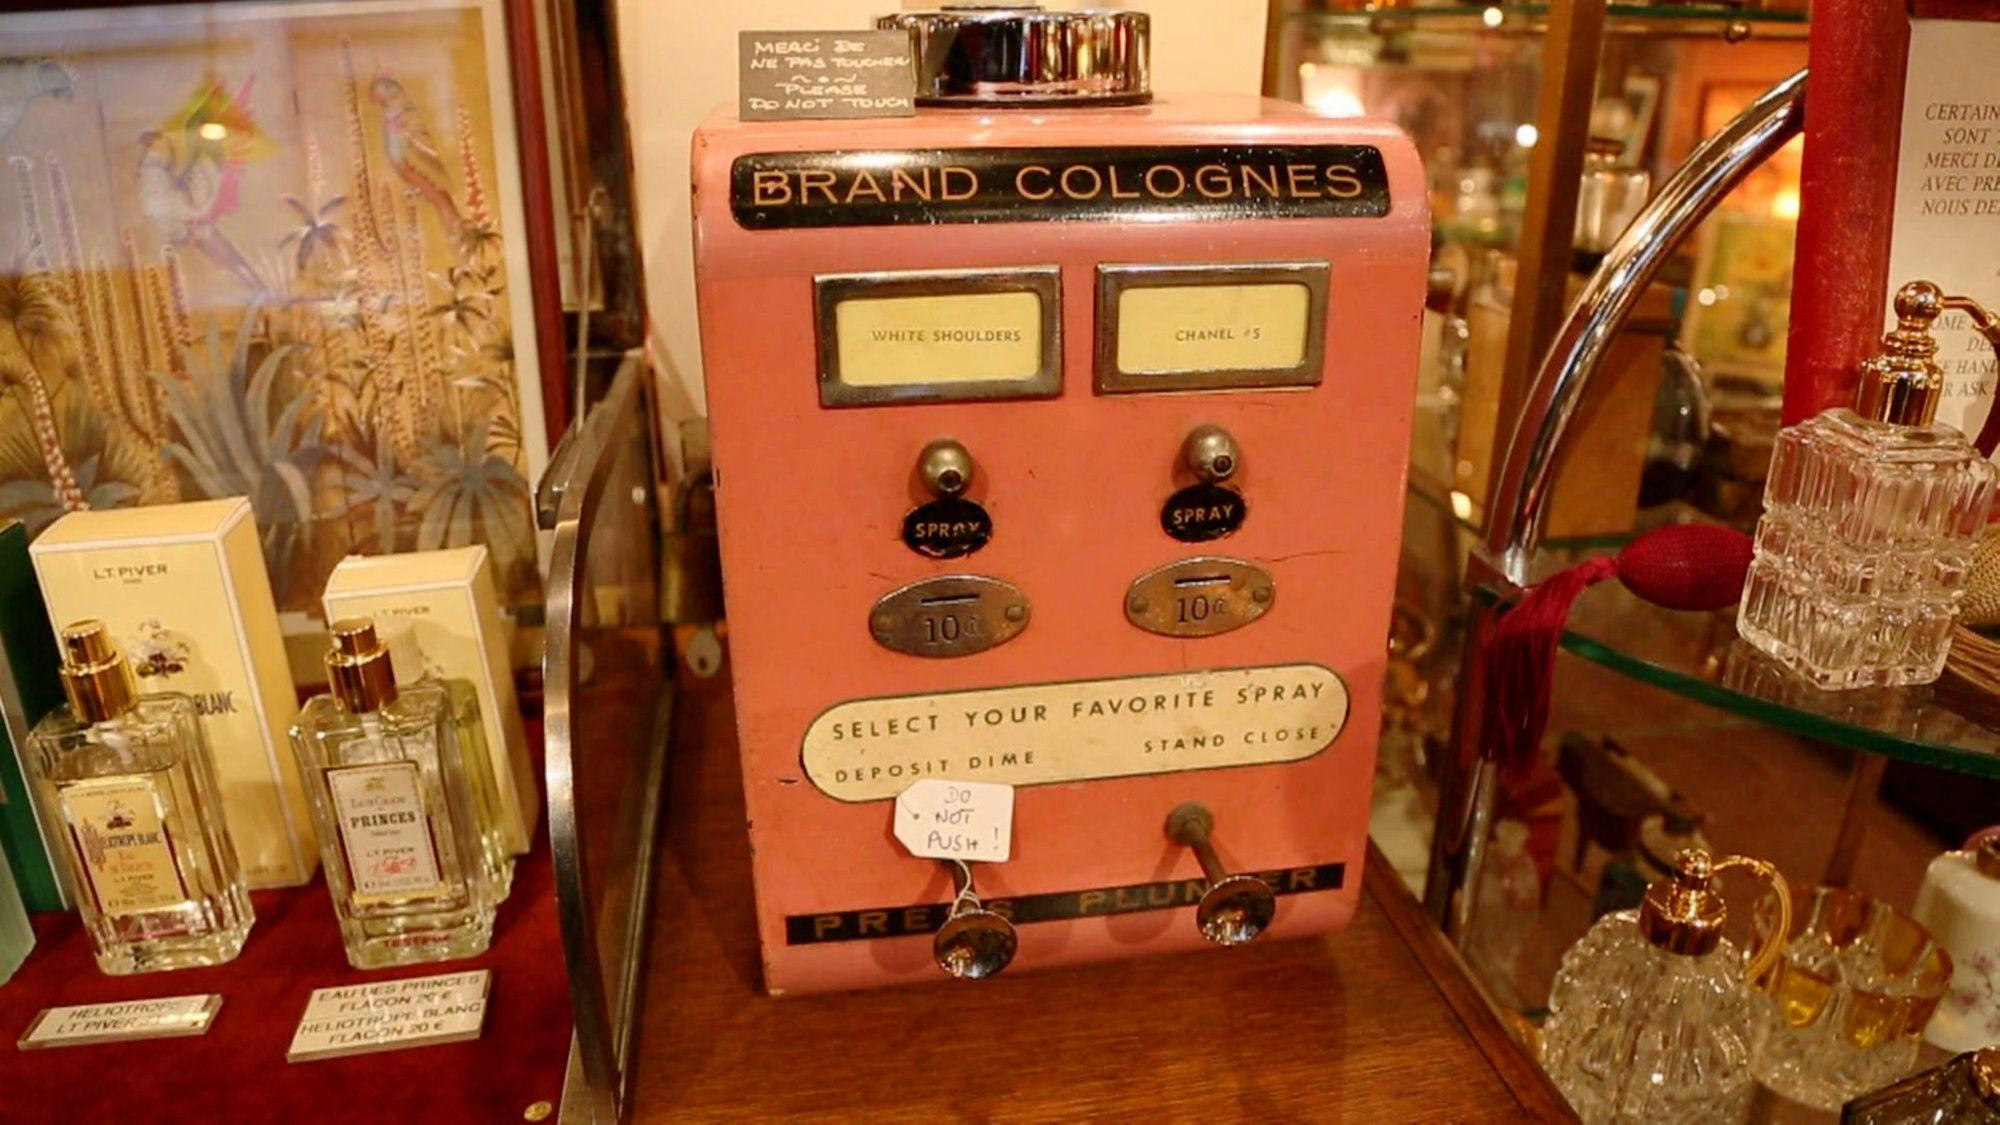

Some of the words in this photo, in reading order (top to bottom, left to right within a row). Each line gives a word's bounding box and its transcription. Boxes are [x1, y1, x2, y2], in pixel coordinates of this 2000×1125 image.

[750, 58, 778, 70] NE
[784, 56, 827, 69] PAS
[775, 82, 868, 96] PLEASE
[749, 98, 780, 110] DO
[785, 98, 834, 109] NOT
[839, 97, 909, 109] TOUCH
[1943, 127, 1992, 144] SONT
[1924, 152, 1979, 168] MERCI
[752, 164, 979, 206] BRAND
[1014, 164, 1363, 201] COLOGNES
[1921, 176, 1969, 192] AVEC
[1920, 198, 1970, 215] NOUS
[872, 329, 925, 343] WHITE
[933, 329, 1022, 343] SHOULDERS
[1174, 328, 1236, 342] CHANEL
[1958, 381, 1989, 397] ASK
[1172, 504, 1235, 525] SPRAY
[915, 521, 981, 538] SPRAY
[118, 563, 168, 578] PIVER
[832, 714, 939, 742] SELECT
[964, 704, 1048, 728] YOUR
[1072, 690, 1216, 719] FAVORITE
[1236, 682, 1325, 706] SPRAY
[1143, 733, 1226, 754] STAND
[1243, 726, 1320, 745] CLOSE
[835, 758, 951, 784] DEPOSIT
[968, 750, 1035, 770] DIME
[944, 785, 973, 805] DO
[350, 811, 417, 829] PRINCES
[935, 808, 975, 825] NOT
[813, 900, 1015, 939] PRES
[402, 974, 481, 993] PRINCES
[338, 996, 411, 1013] FLACON
[82, 1016, 138, 1032] PIVER
[328, 1025, 404, 1045] FLACON
[409, 1021, 430, 1034] 20
